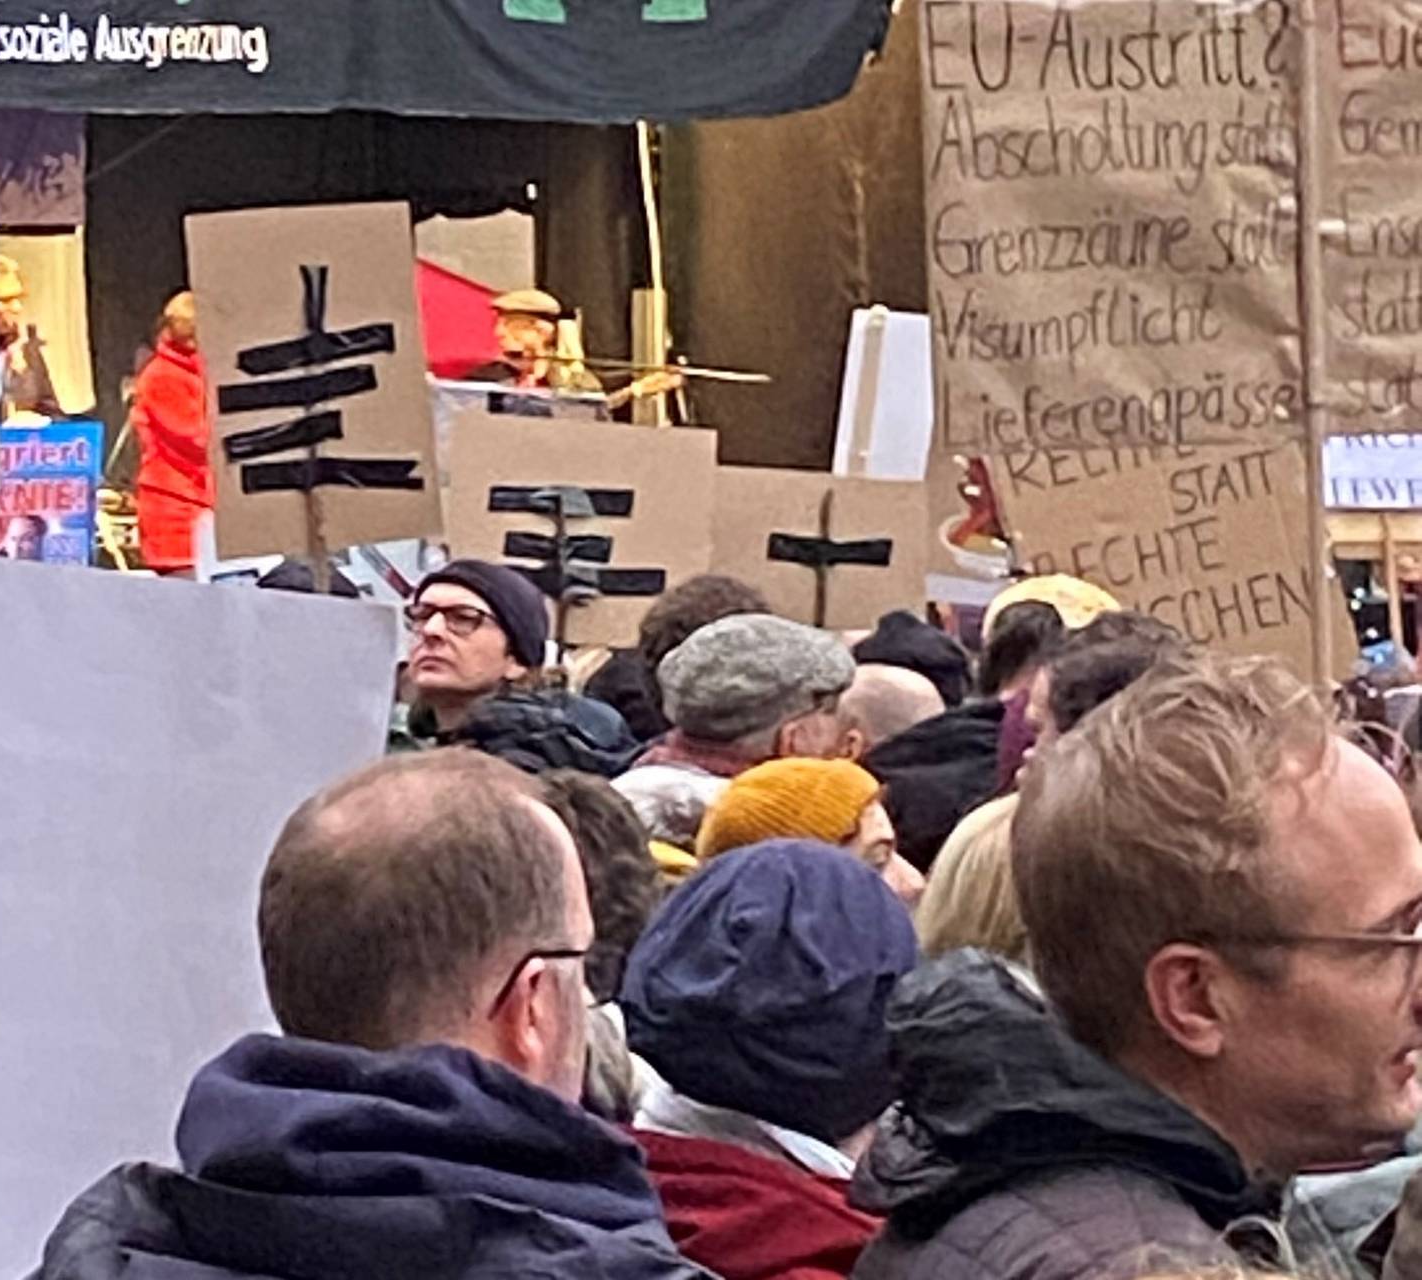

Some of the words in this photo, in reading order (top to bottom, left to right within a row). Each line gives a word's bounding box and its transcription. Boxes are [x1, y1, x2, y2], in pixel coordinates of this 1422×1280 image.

[94, 14, 268, 72] Ausgrenzung
[925, 0, 1290, 92] EU-Austritt?
[932, 201, 1191, 279] Grenzzäune
[935, 282, 1224, 370] Visumpflicht
[940, 373, 1298, 450] Lieferengpässe
[1170, 449, 1275, 514] STATT
